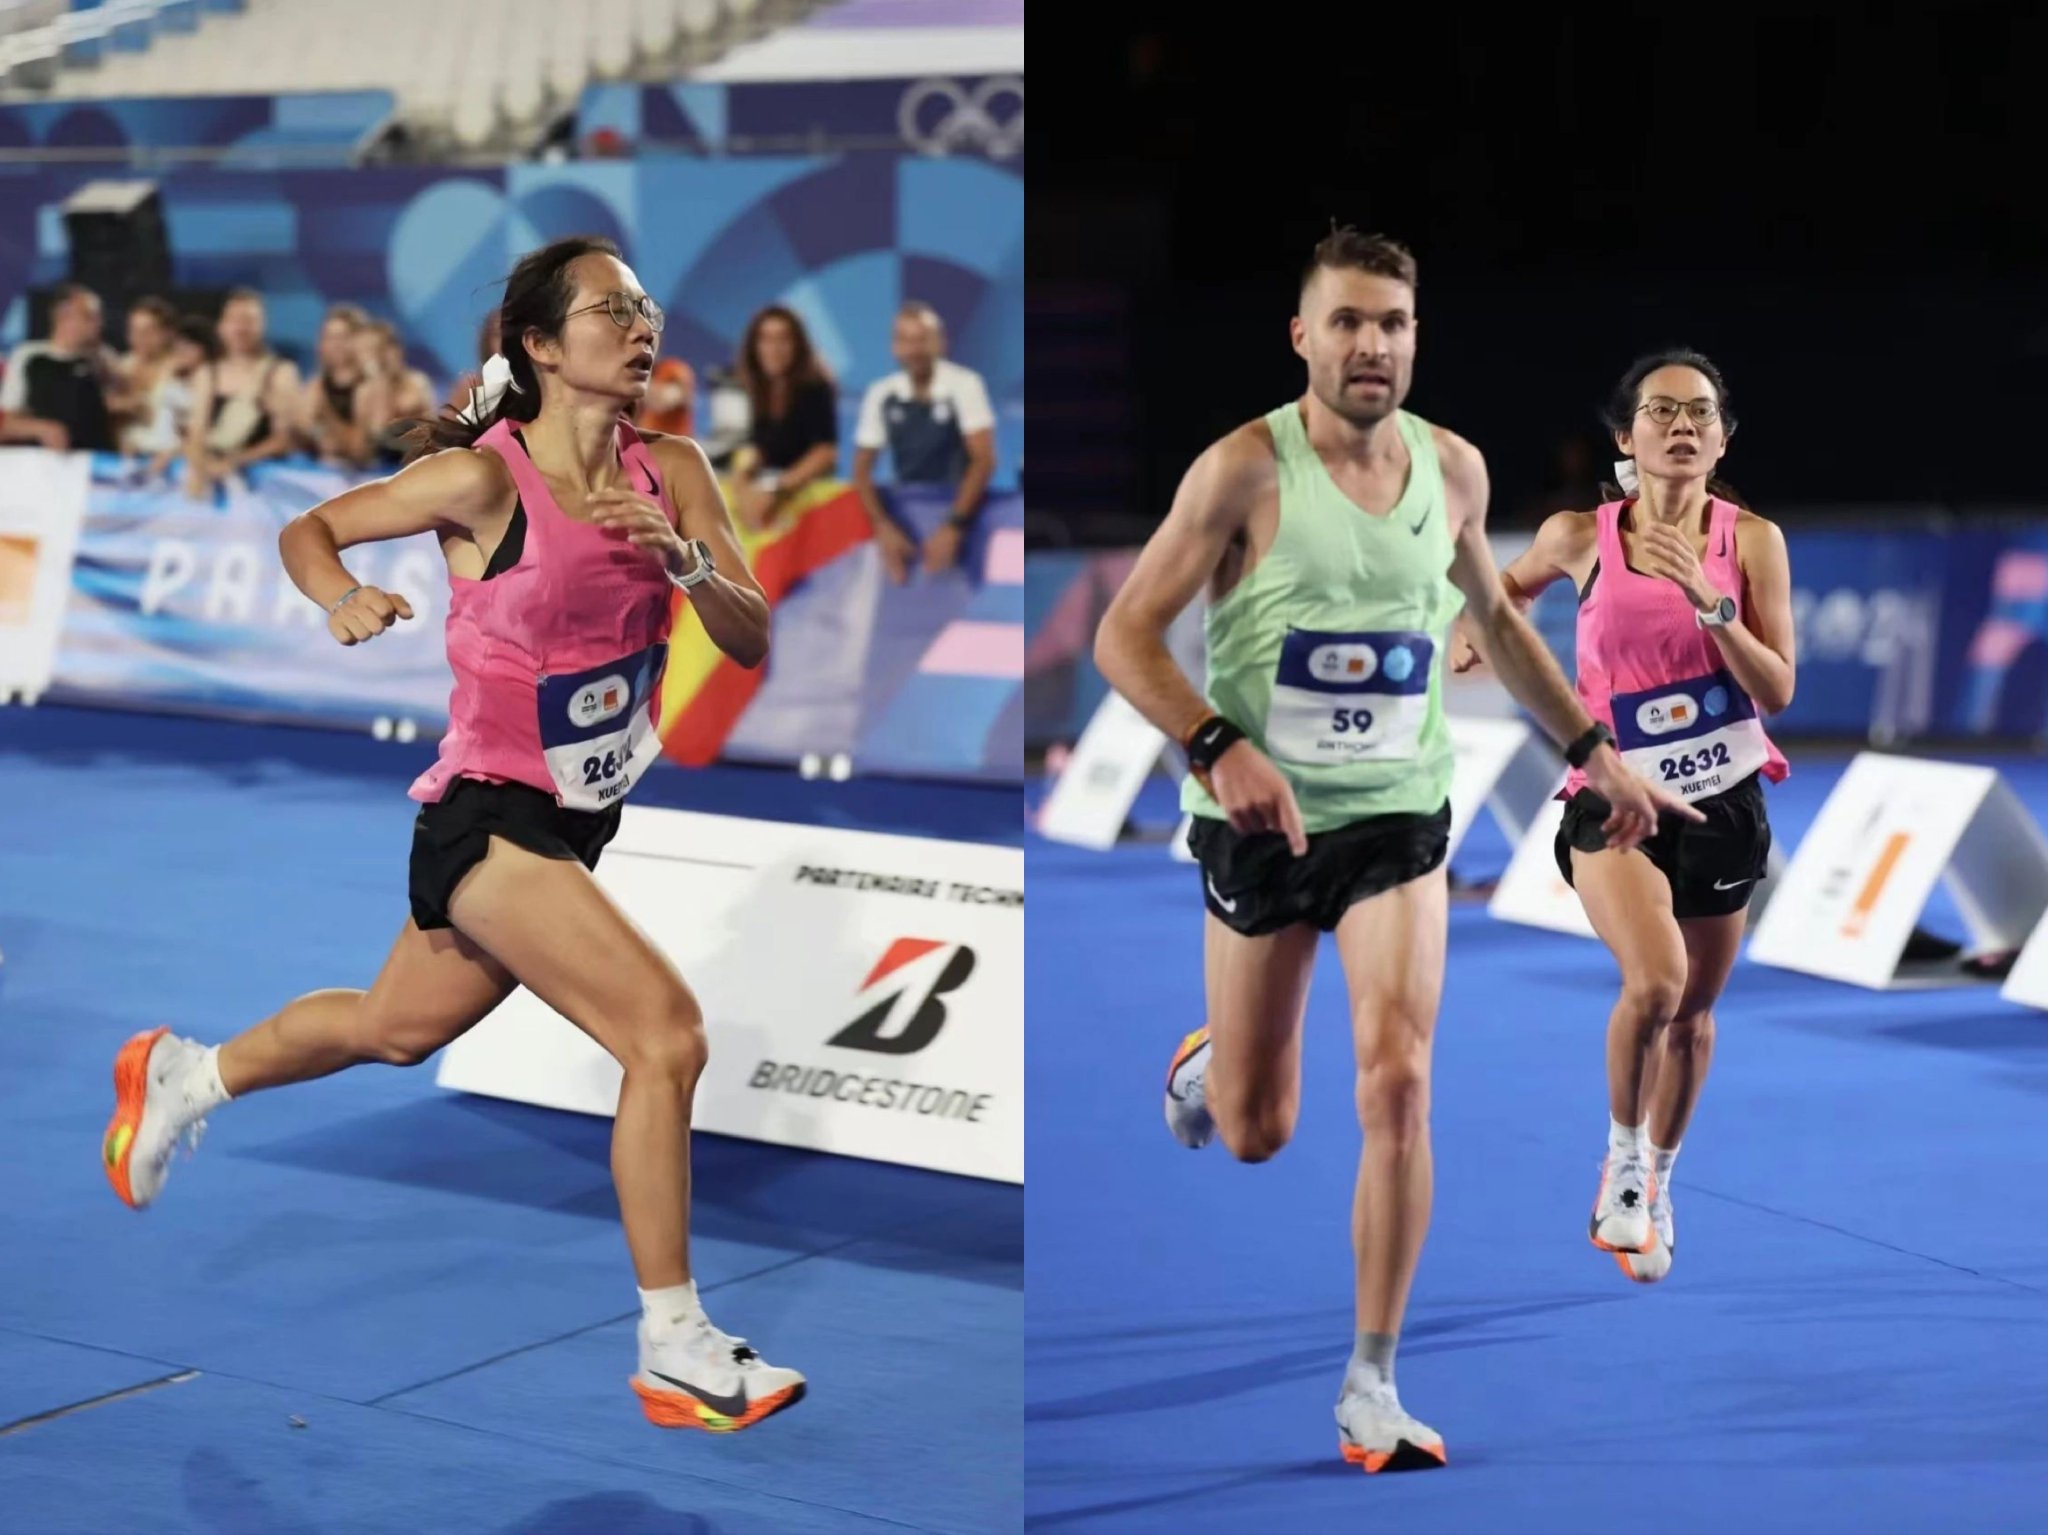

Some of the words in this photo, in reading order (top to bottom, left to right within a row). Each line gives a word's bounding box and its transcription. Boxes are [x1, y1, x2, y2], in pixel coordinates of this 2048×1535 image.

[1332, 708, 1373, 733] 59
[1660, 741, 1731, 781] 2632
[1681, 774, 1721, 795] XUEMEI
[747, 1059, 994, 1123] BRIDGESTONE
